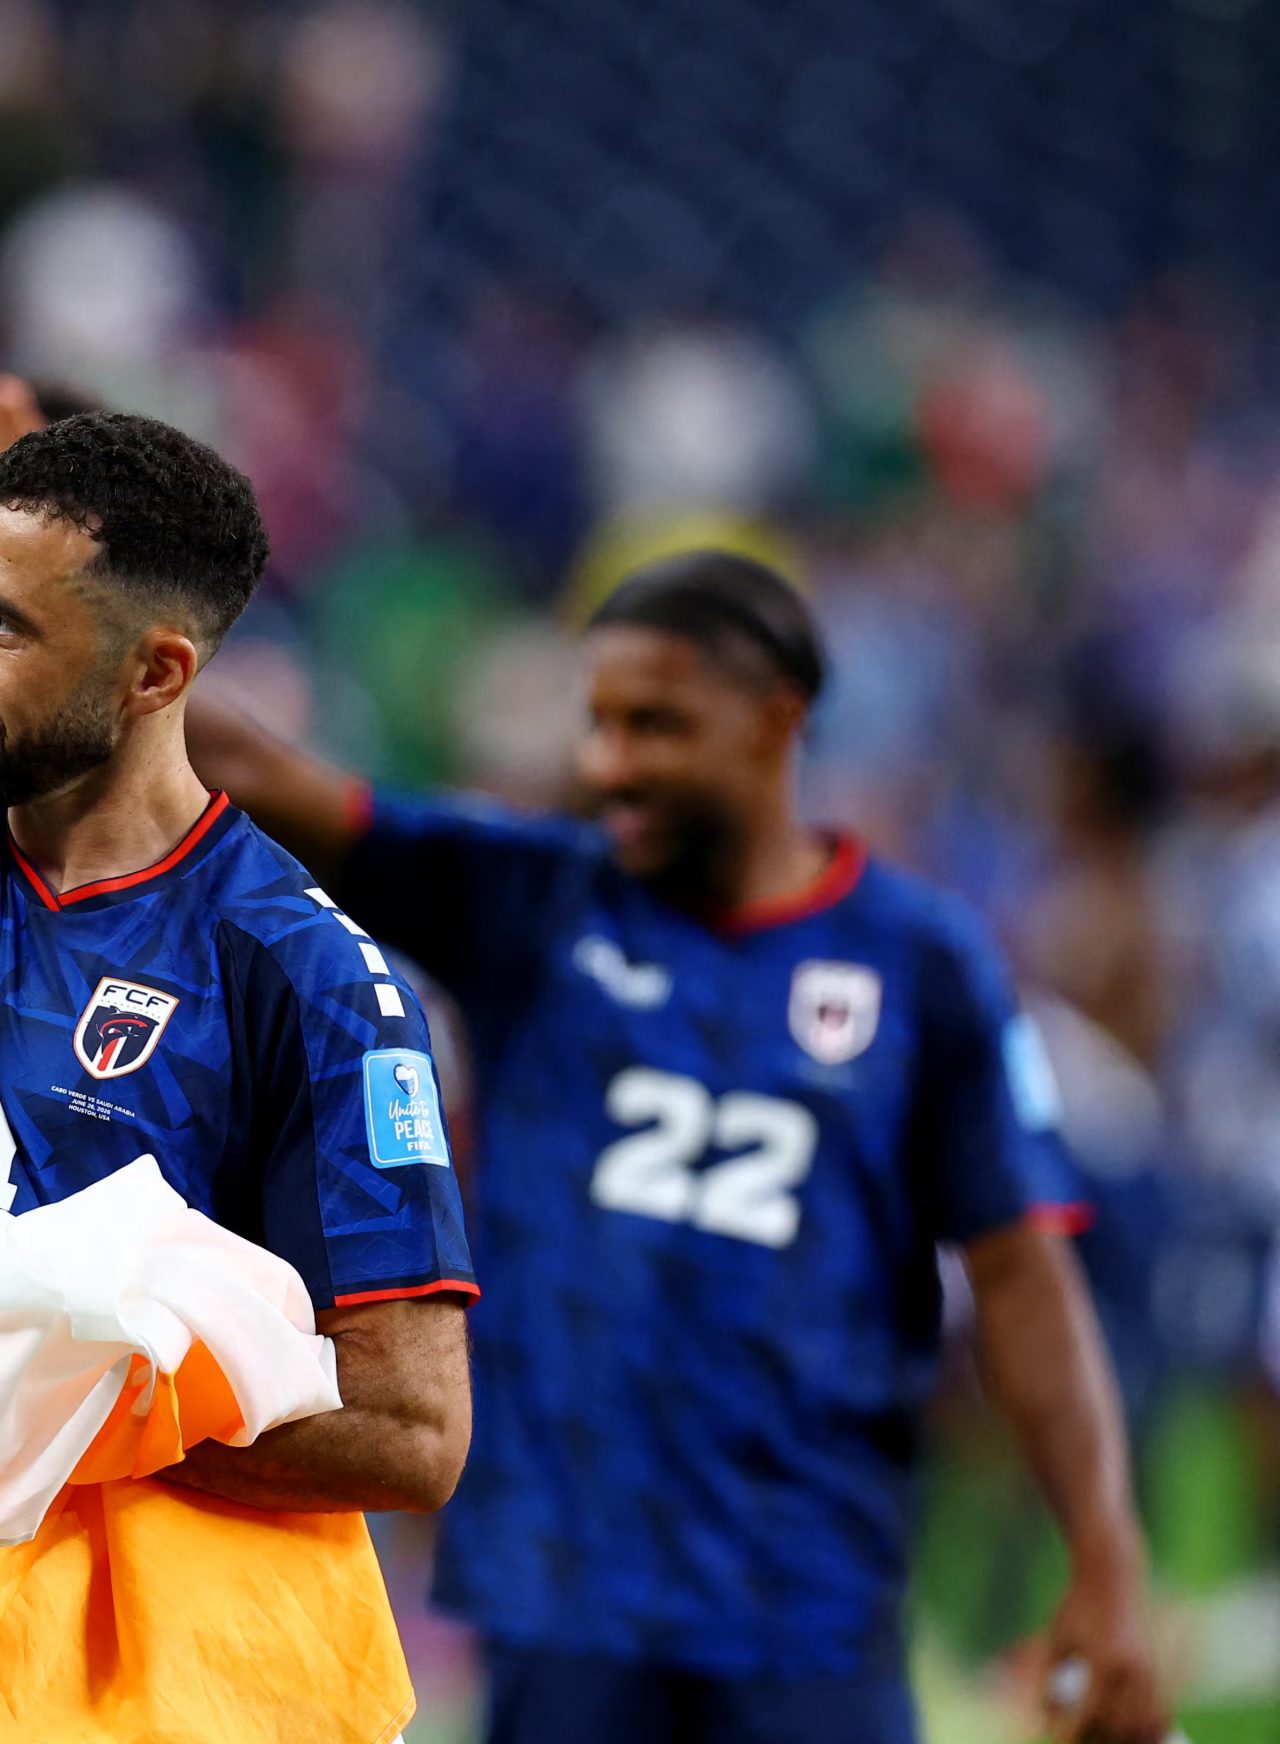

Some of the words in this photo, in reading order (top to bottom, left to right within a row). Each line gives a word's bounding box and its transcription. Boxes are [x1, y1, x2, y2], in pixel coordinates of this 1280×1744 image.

[103, 984, 169, 1007] FCF
[50, 1085, 68, 1095] CABO
[68, 1089, 87, 1101] VERDE
[87, 1095, 96, 1104] VS
[95, 1098, 114, 1109] SAUDI
[113, 1105, 136, 1118] ARABIA
[71, 1098, 87, 1107] JUNE
[96, 1105, 111, 1115] 2026
[98, 1113, 111, 1122] USA
[394, 1119, 434, 1140] PEACE
[406, 1140, 432, 1152] FIFA
[591, 1066, 819, 1248] 22
